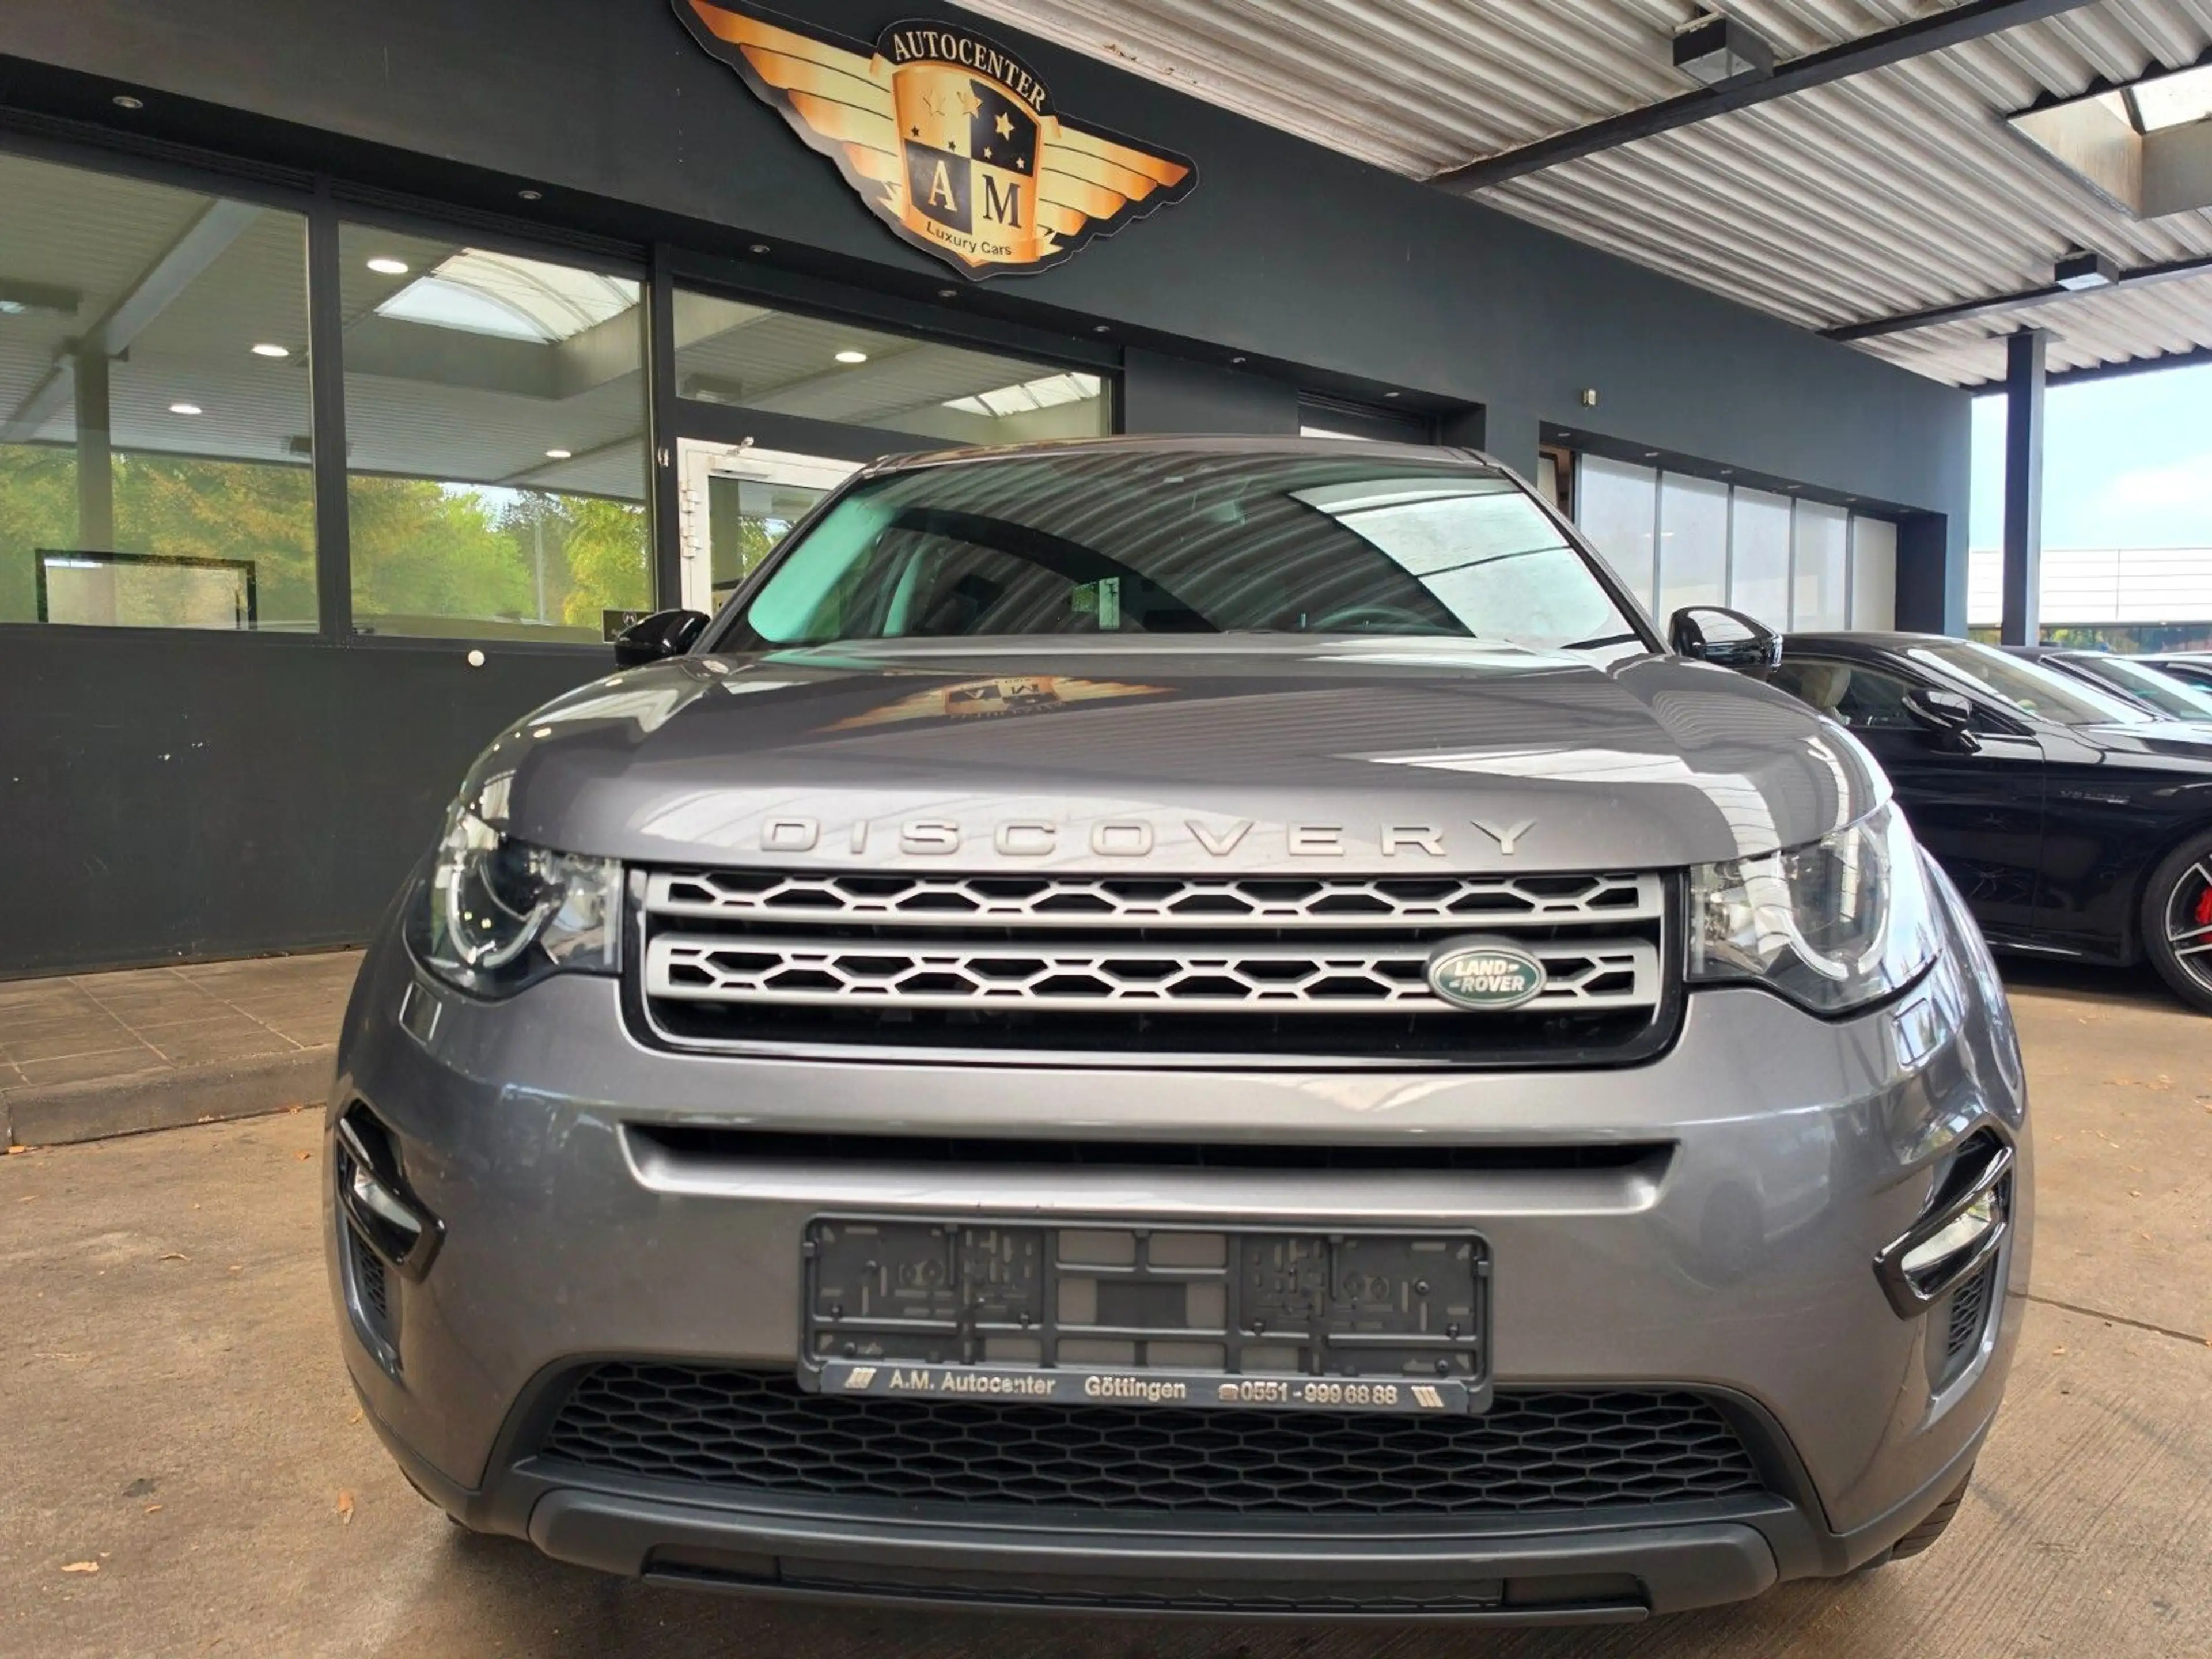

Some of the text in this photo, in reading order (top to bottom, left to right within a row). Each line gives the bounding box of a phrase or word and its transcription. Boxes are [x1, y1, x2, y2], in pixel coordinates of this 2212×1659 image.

[893, 31, 1046, 112] AUTOCENTER
[928, 160, 1022, 228] A M
[926, 221, 1012, 256] Luxury Cars
[760, 817, 1537, 856] DISCOVERY
[1454, 959, 1508, 976] LAND
[1460, 975, 1526, 993] ROVER
[889, 1369, 935, 1391] A.M.
[941, 1371, 1056, 1395] Autocenter
[1085, 1374, 1186, 1402] Göttingen
